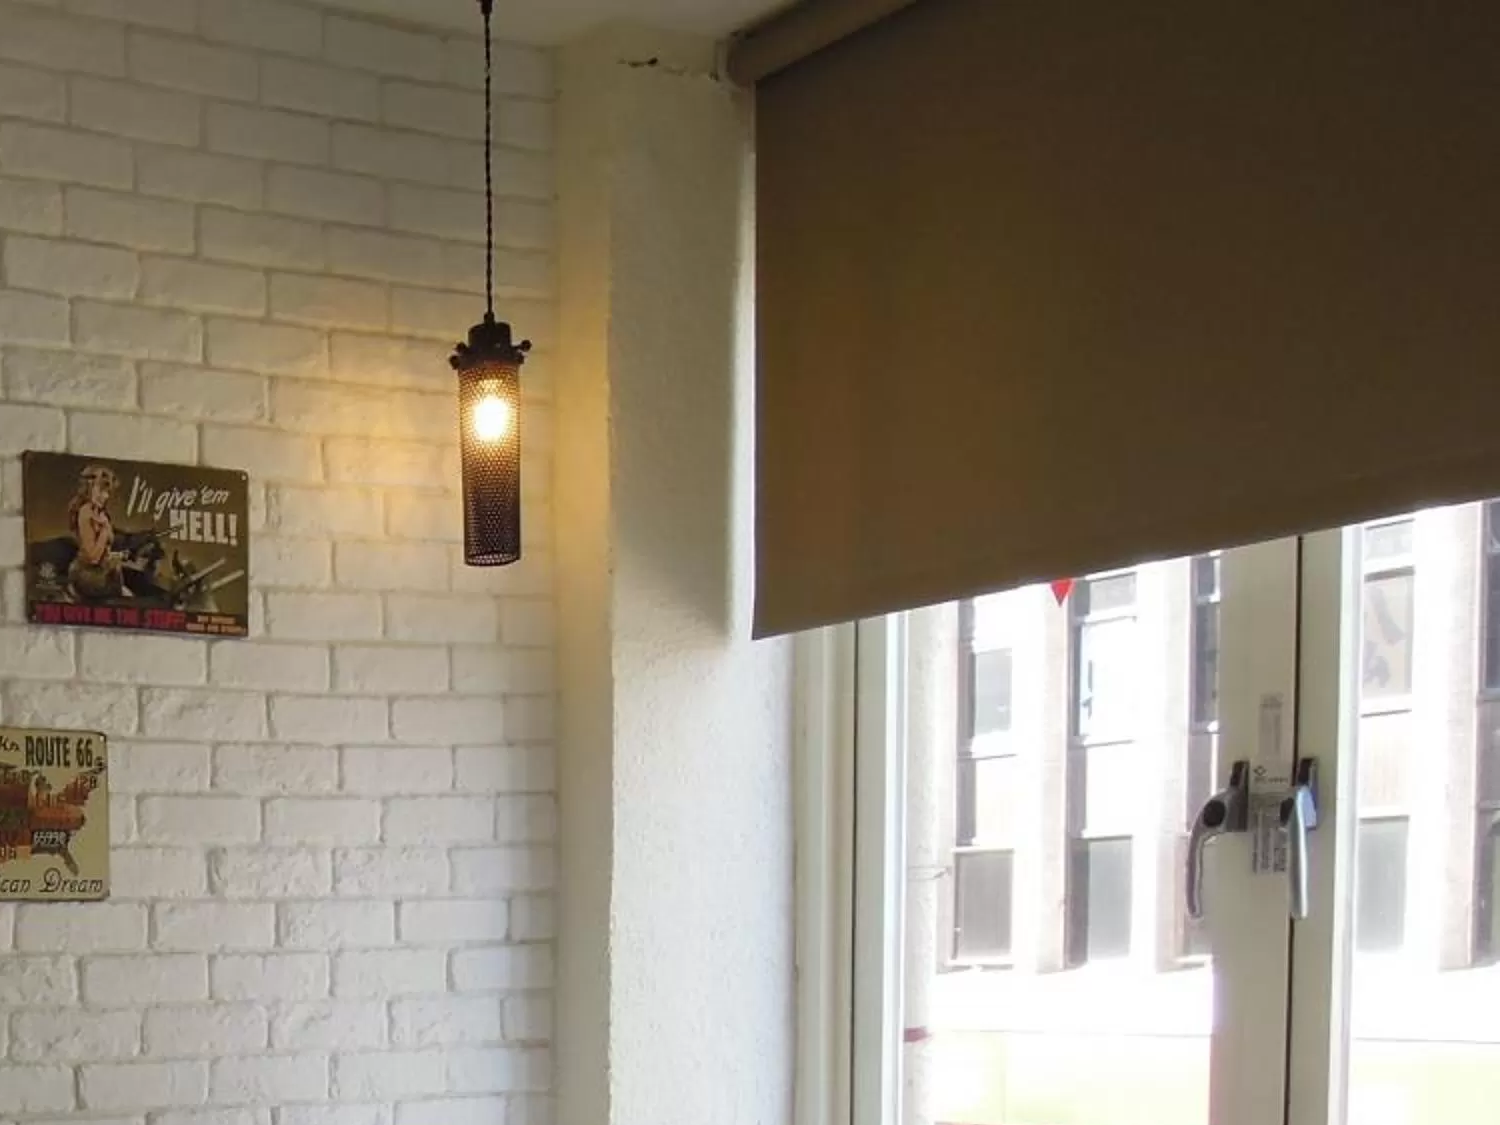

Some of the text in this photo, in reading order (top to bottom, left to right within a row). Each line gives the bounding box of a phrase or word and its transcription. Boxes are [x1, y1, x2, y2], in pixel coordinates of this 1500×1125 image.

[126, 474, 152, 517] I'll
[154, 488, 198, 521] give
[169, 508, 238, 547] HELL!
[24, 735, 71, 768] ROUTE
[75, 737, 94, 769] 66
[38, 867, 104, 894] Dream
